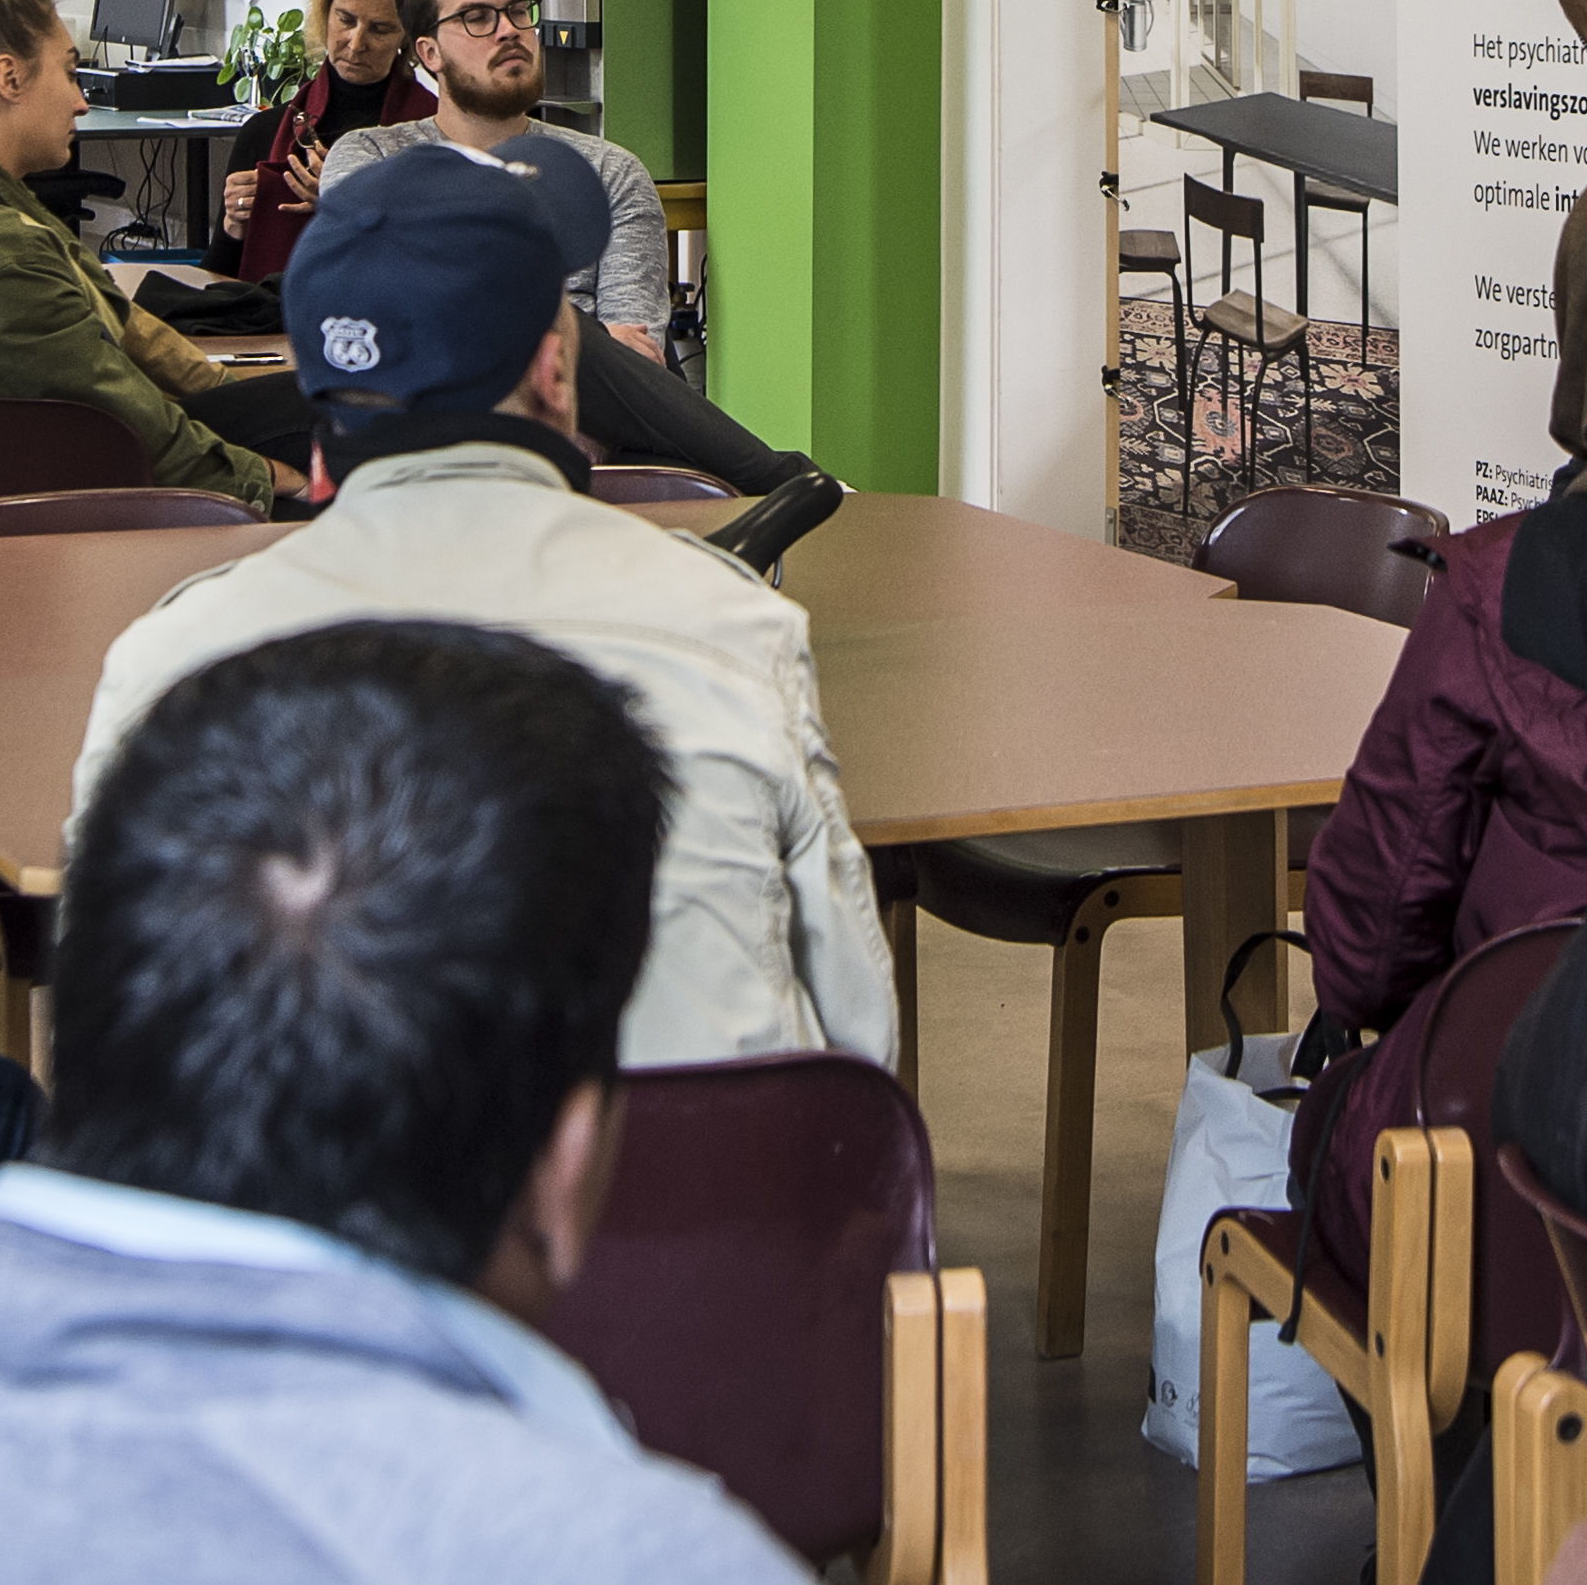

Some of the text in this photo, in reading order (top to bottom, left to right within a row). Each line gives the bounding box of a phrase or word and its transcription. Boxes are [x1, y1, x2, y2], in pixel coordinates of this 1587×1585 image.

[1473, 34, 1587, 69] Het psychiatr
[1474, 131, 1500, 156] We
[1505, 135, 1568, 163] werken
[1474, 181, 1550, 211] optimale
[1475, 275, 1501, 302] We
[1475, 329, 1558, 361] zorgpartn
[1475, 460, 1553, 490] PZ: Psychiatris
[1476, 485, 1508, 506] PAAZ:
